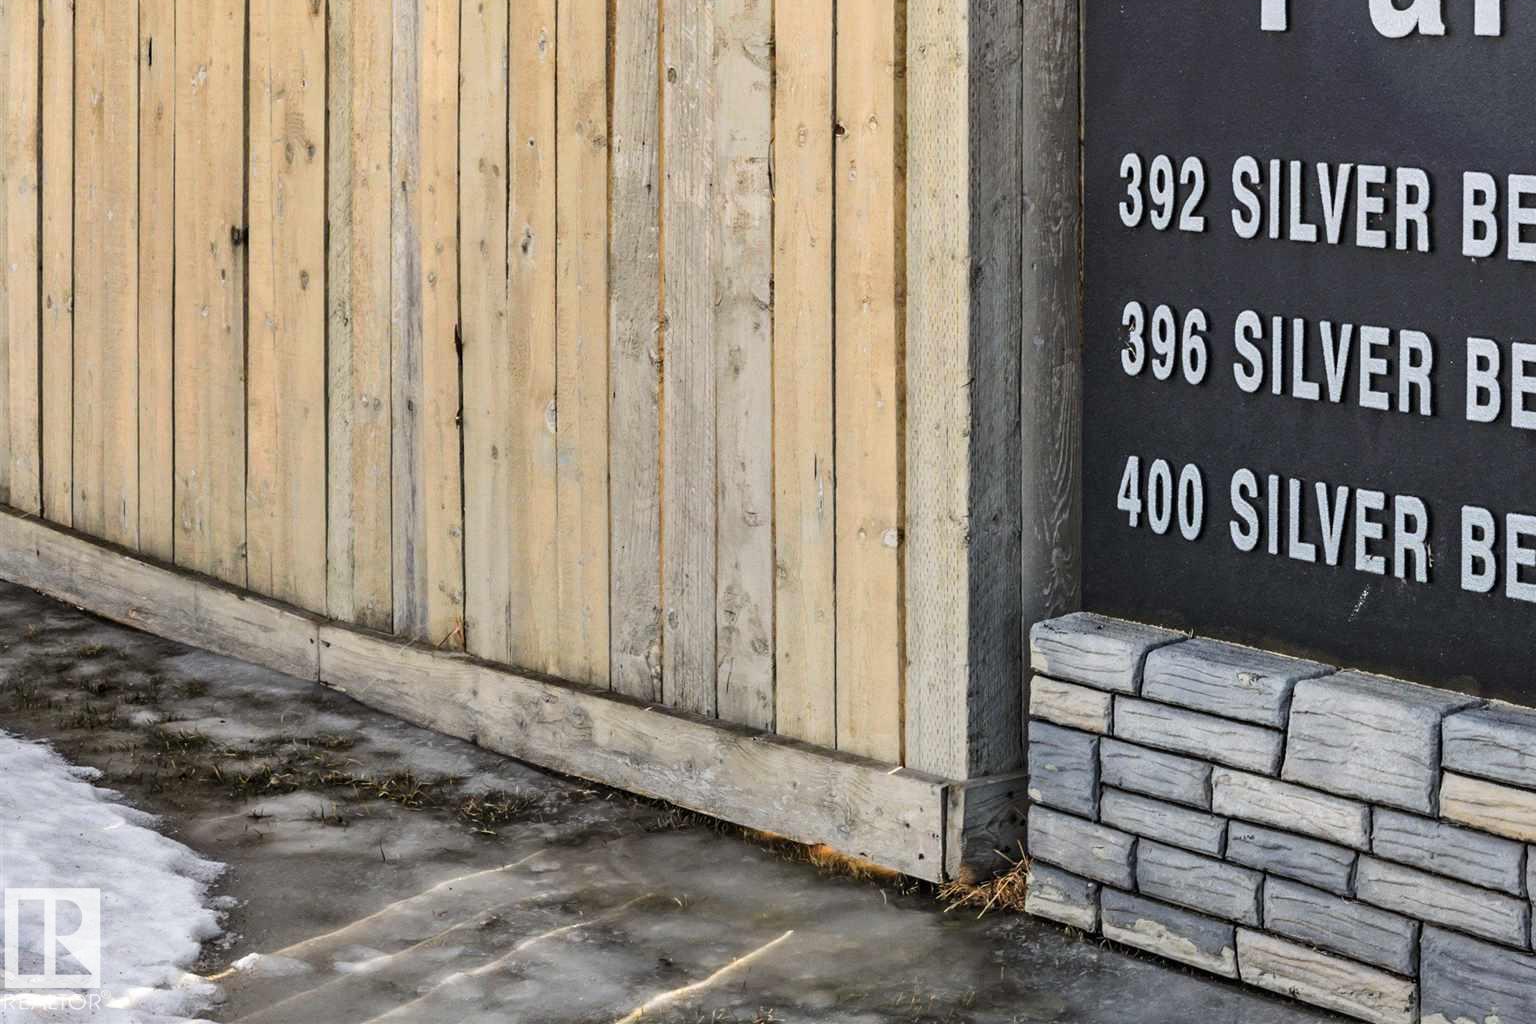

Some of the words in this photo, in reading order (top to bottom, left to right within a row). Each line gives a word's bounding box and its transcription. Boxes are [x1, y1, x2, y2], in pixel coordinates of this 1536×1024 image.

[1118, 153, 1206, 233] 392
[1231, 155, 1431, 253] SILVER
[1120, 301, 1208, 386] 396
[1233, 310, 1434, 417] SILVER
[1116, 454, 1204, 541] 400
[1229, 468, 1430, 584] SILVER
